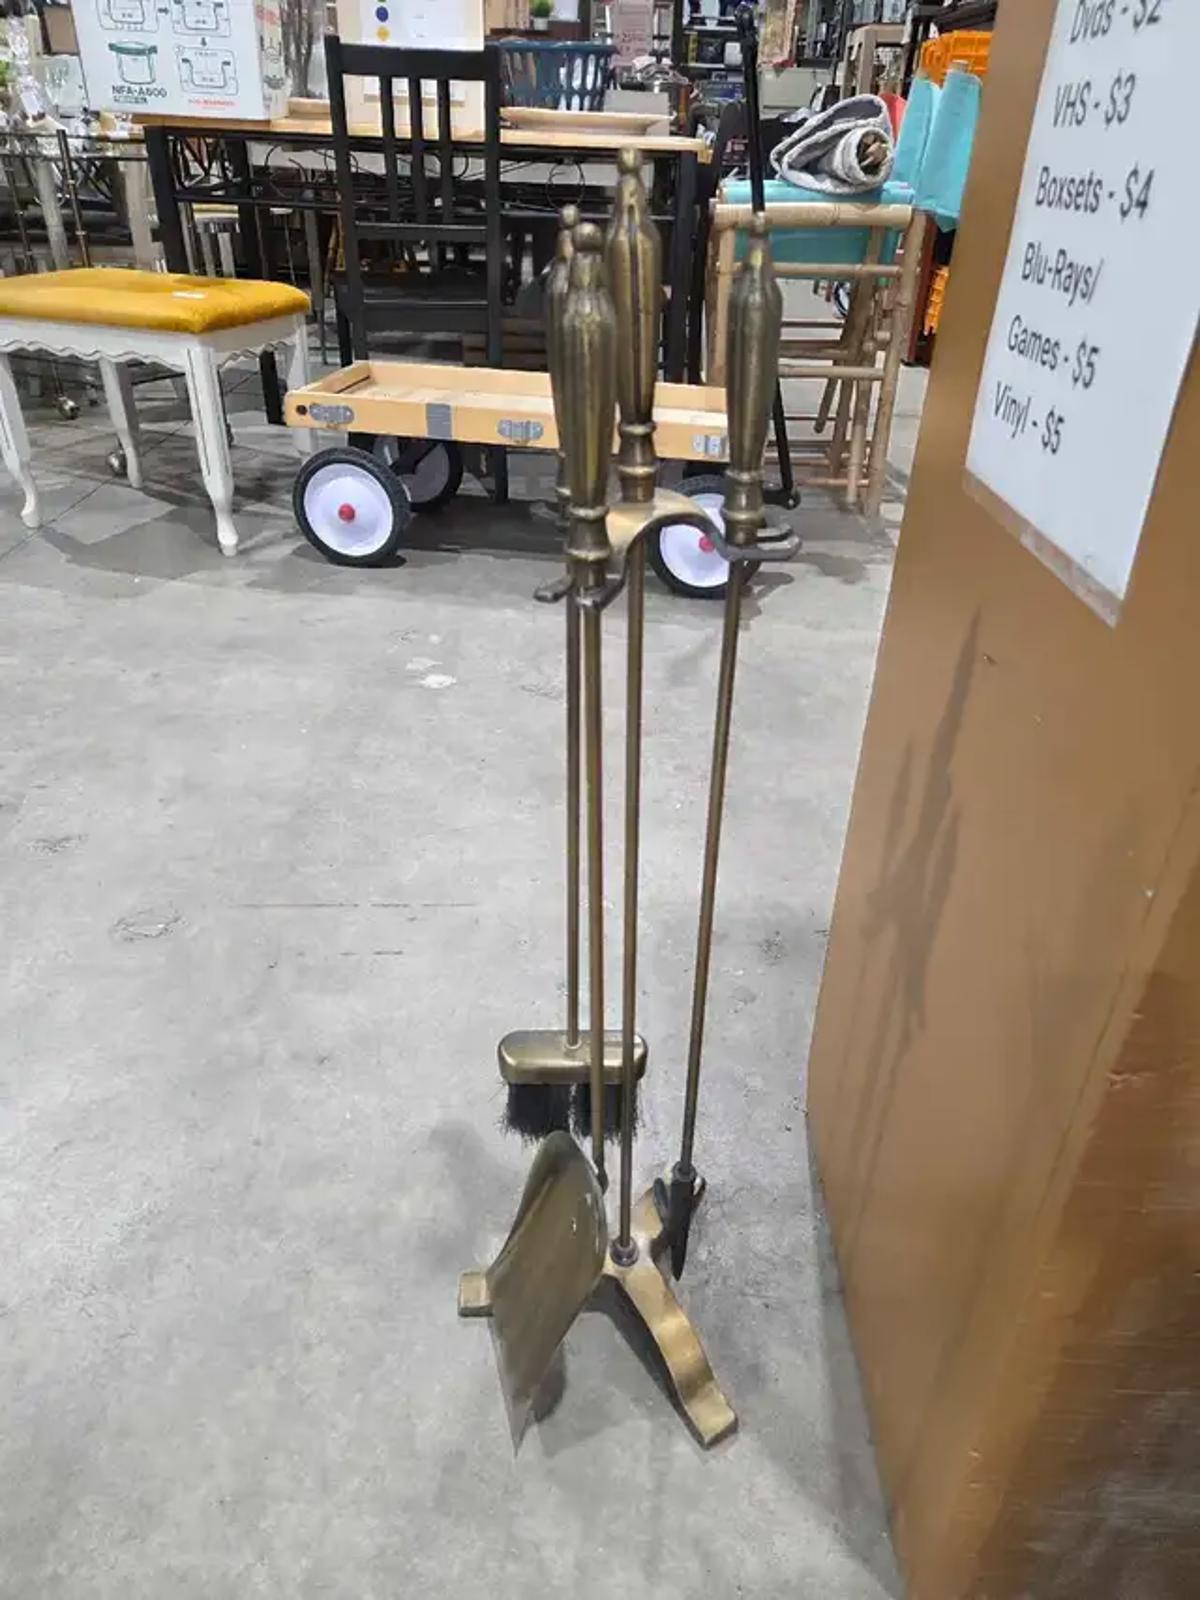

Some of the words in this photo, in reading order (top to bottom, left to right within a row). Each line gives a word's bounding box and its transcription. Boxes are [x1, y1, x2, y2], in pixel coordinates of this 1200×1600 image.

[1053, 80, 1092, 128] VHS
[1104, 68, 1137, 131] $3
[1035, 165, 1104, 214] Boxsets
[1119, 160, 1155, 225] $4
[1021, 241, 1105, 307] Blu-Rays/
[1007, 314, 1061, 371] Games
[1072, 334, 1101, 390] $5
[994, 380, 1032, 439] Vinyl
[1041, 404, 1066, 456] $5
